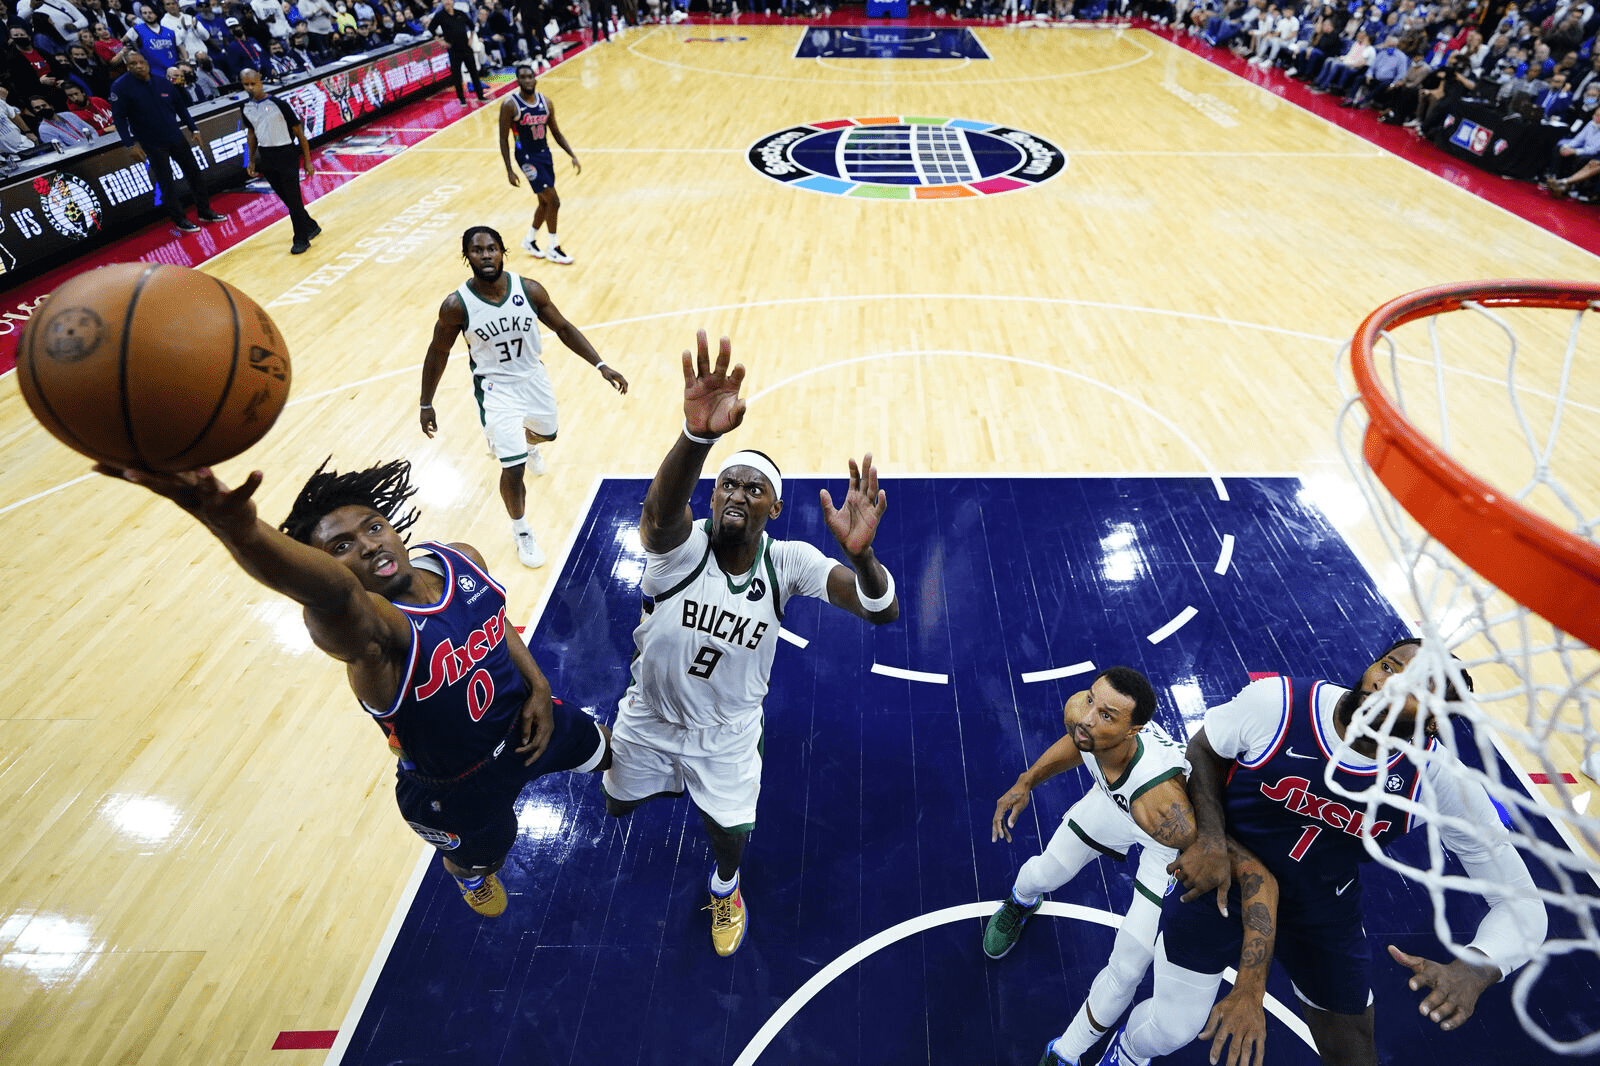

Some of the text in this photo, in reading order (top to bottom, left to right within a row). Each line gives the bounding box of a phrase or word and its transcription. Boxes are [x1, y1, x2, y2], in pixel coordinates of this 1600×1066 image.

[98, 158, 154, 206] FRIDAY
[209, 128, 249, 163] ESP
[72, 175, 102, 214] CELTICS
[10, 207, 43, 240] VS
[375, 212, 459, 264] CENTER
[263, 184, 463, 309] WELLS FARGO
[474, 316, 532, 342] BUCKS
[495, 337, 523, 363] 37
[682, 599, 768, 650] BUCKS
[415, 605, 506, 702] Sixers
[687, 646, 723, 679] 9
[466, 668, 494, 722] 0
[1288, 824, 1323, 862] 1
